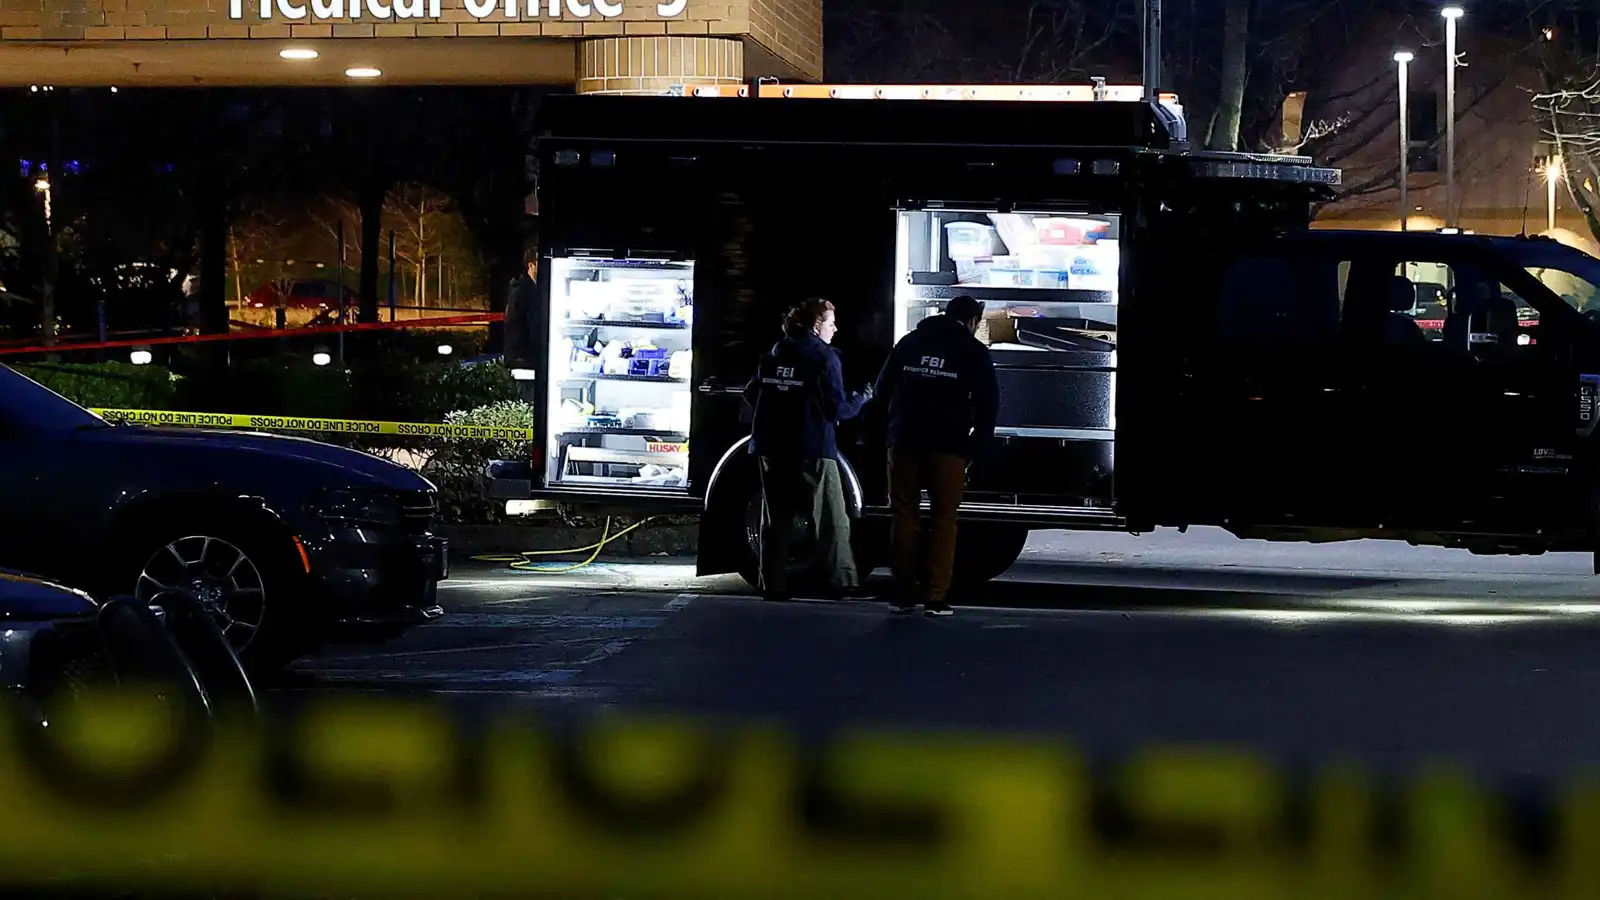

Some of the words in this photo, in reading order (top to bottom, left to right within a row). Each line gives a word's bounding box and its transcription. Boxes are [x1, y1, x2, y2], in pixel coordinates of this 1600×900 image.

[920, 355, 945, 369] FBI
[776, 366, 795, 378] FBI
[102, 410, 136, 421] CROSS
[136, 411, 158, 422] NOT
[159, 412, 174, 423] DO
[175, 413, 197, 424] LINE
[198, 414, 233, 425] POLICE
[250, 416, 284, 427] CROSS
[284, 418, 305, 428] NOT
[306, 419, 321, 429] DO
[323, 420, 344, 431] LINE
[346, 421, 380, 432] POLICE
[398, 424, 431, 434] CROSS
[432, 425, 453, 435] NOT
[454, 426, 468, 437] DO
[470, 427, 491, 438] LINE
[493, 428, 527, 439] POLICE
[649, 444, 681, 453] HUSKY
